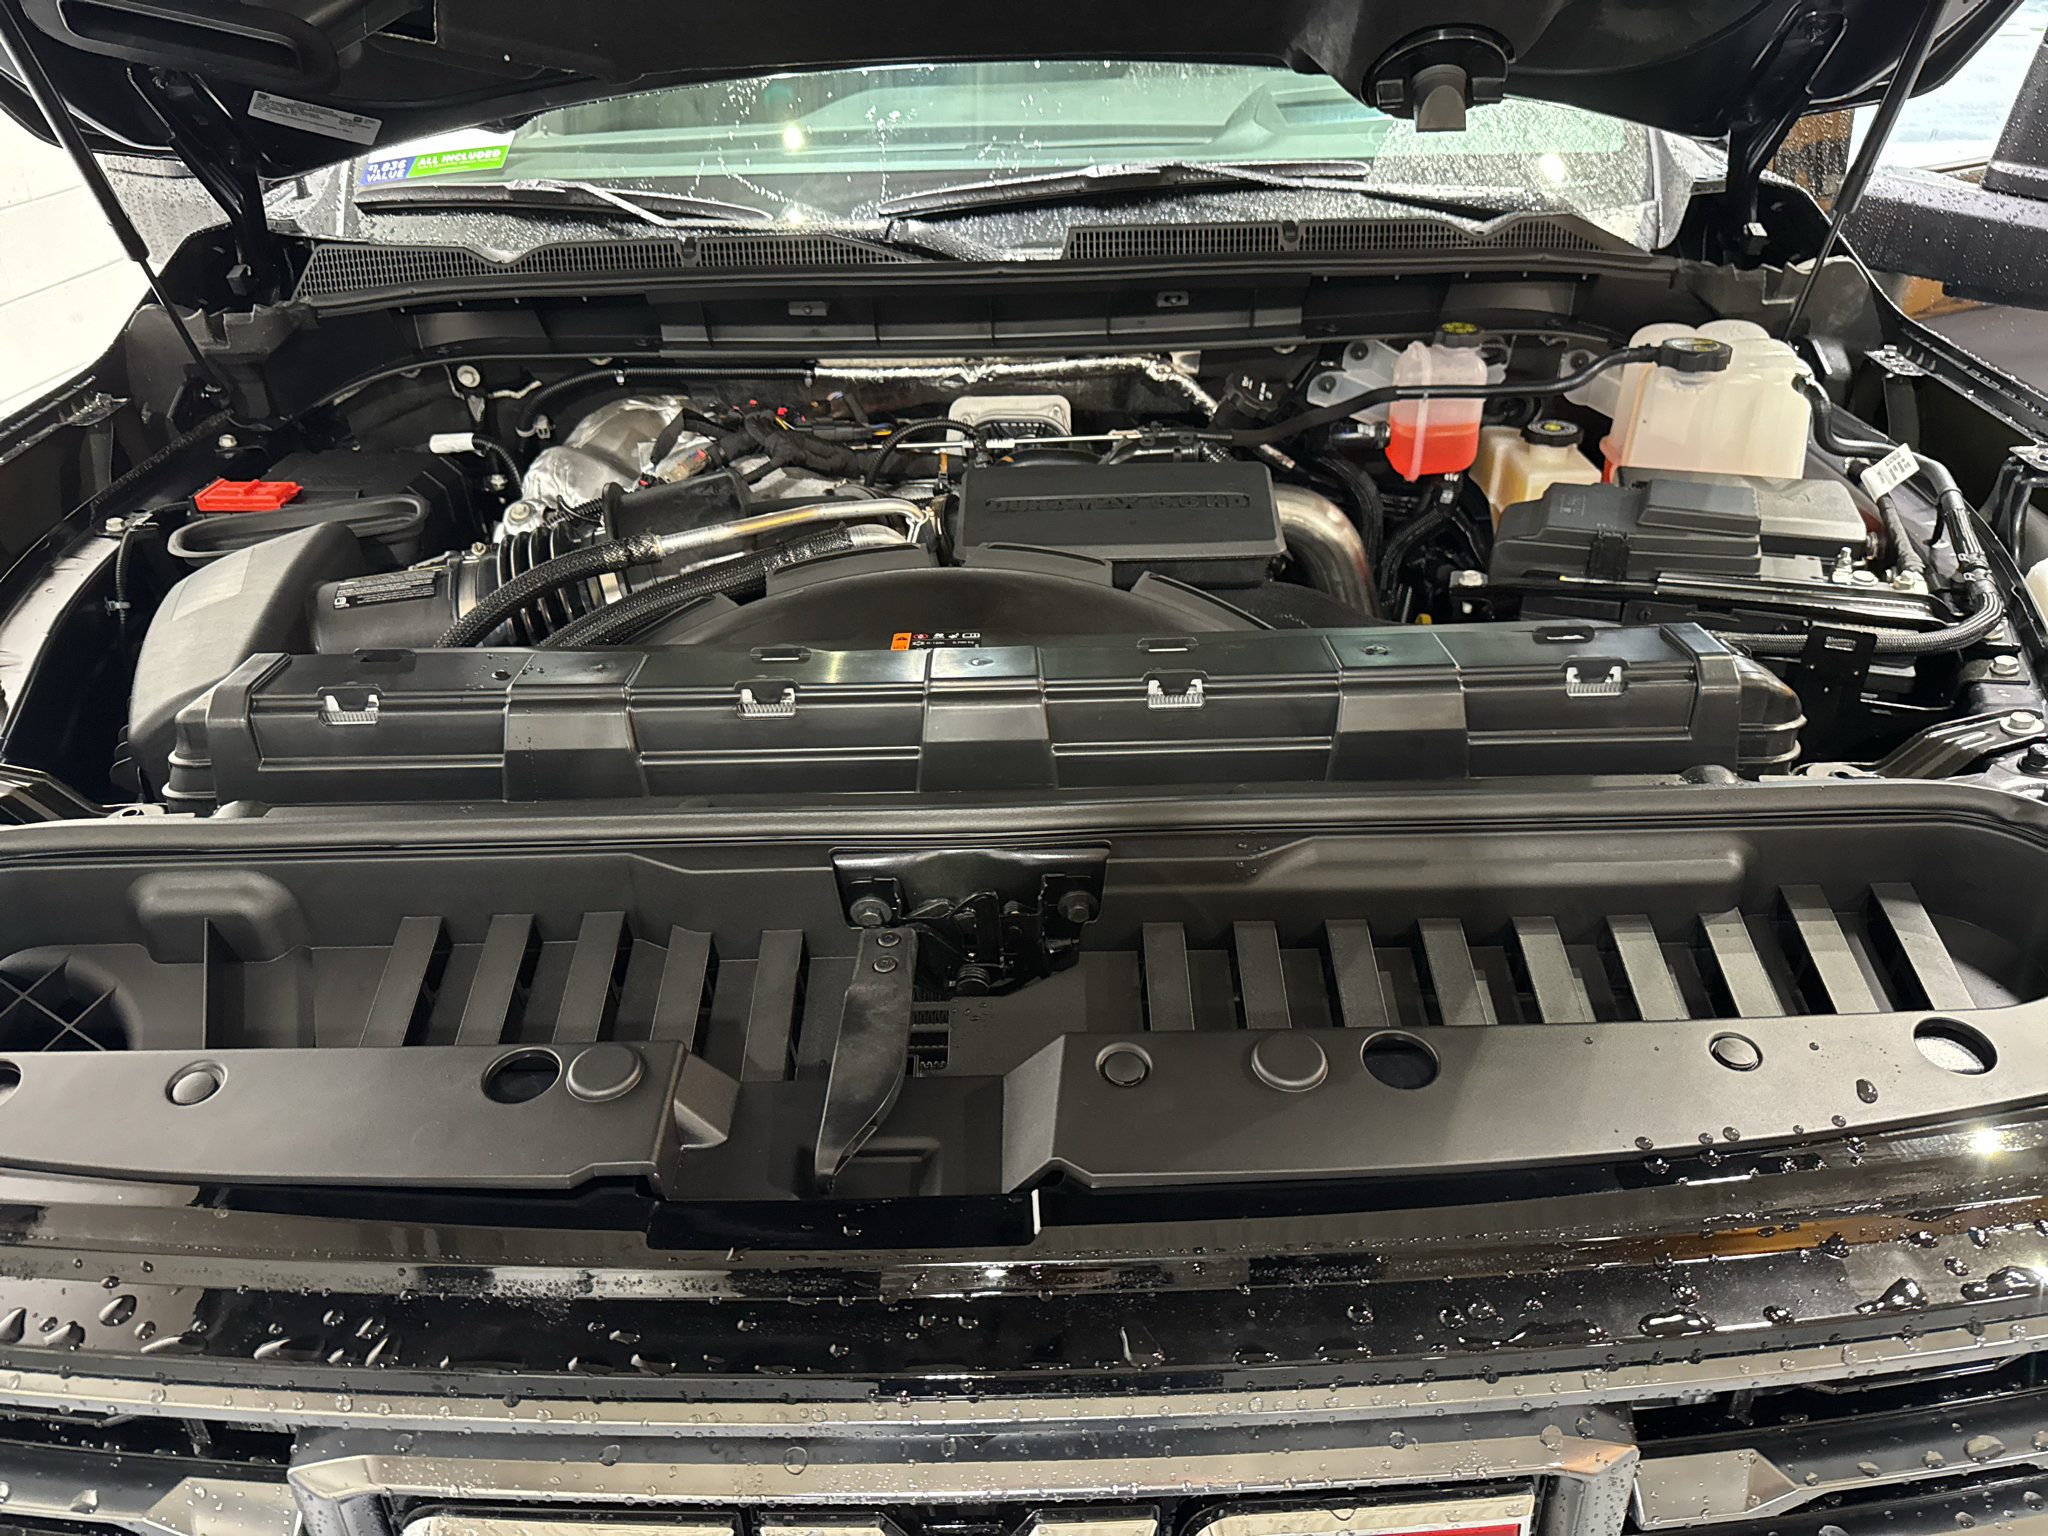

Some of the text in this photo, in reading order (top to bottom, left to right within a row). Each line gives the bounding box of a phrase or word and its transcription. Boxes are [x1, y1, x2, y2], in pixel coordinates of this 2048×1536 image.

[417, 156, 438, 167] ALL
[441, 149, 501, 163] INCLUDED
[366, 168, 405, 183] VALUE
[989, 497, 1133, 512] DURAMAX
